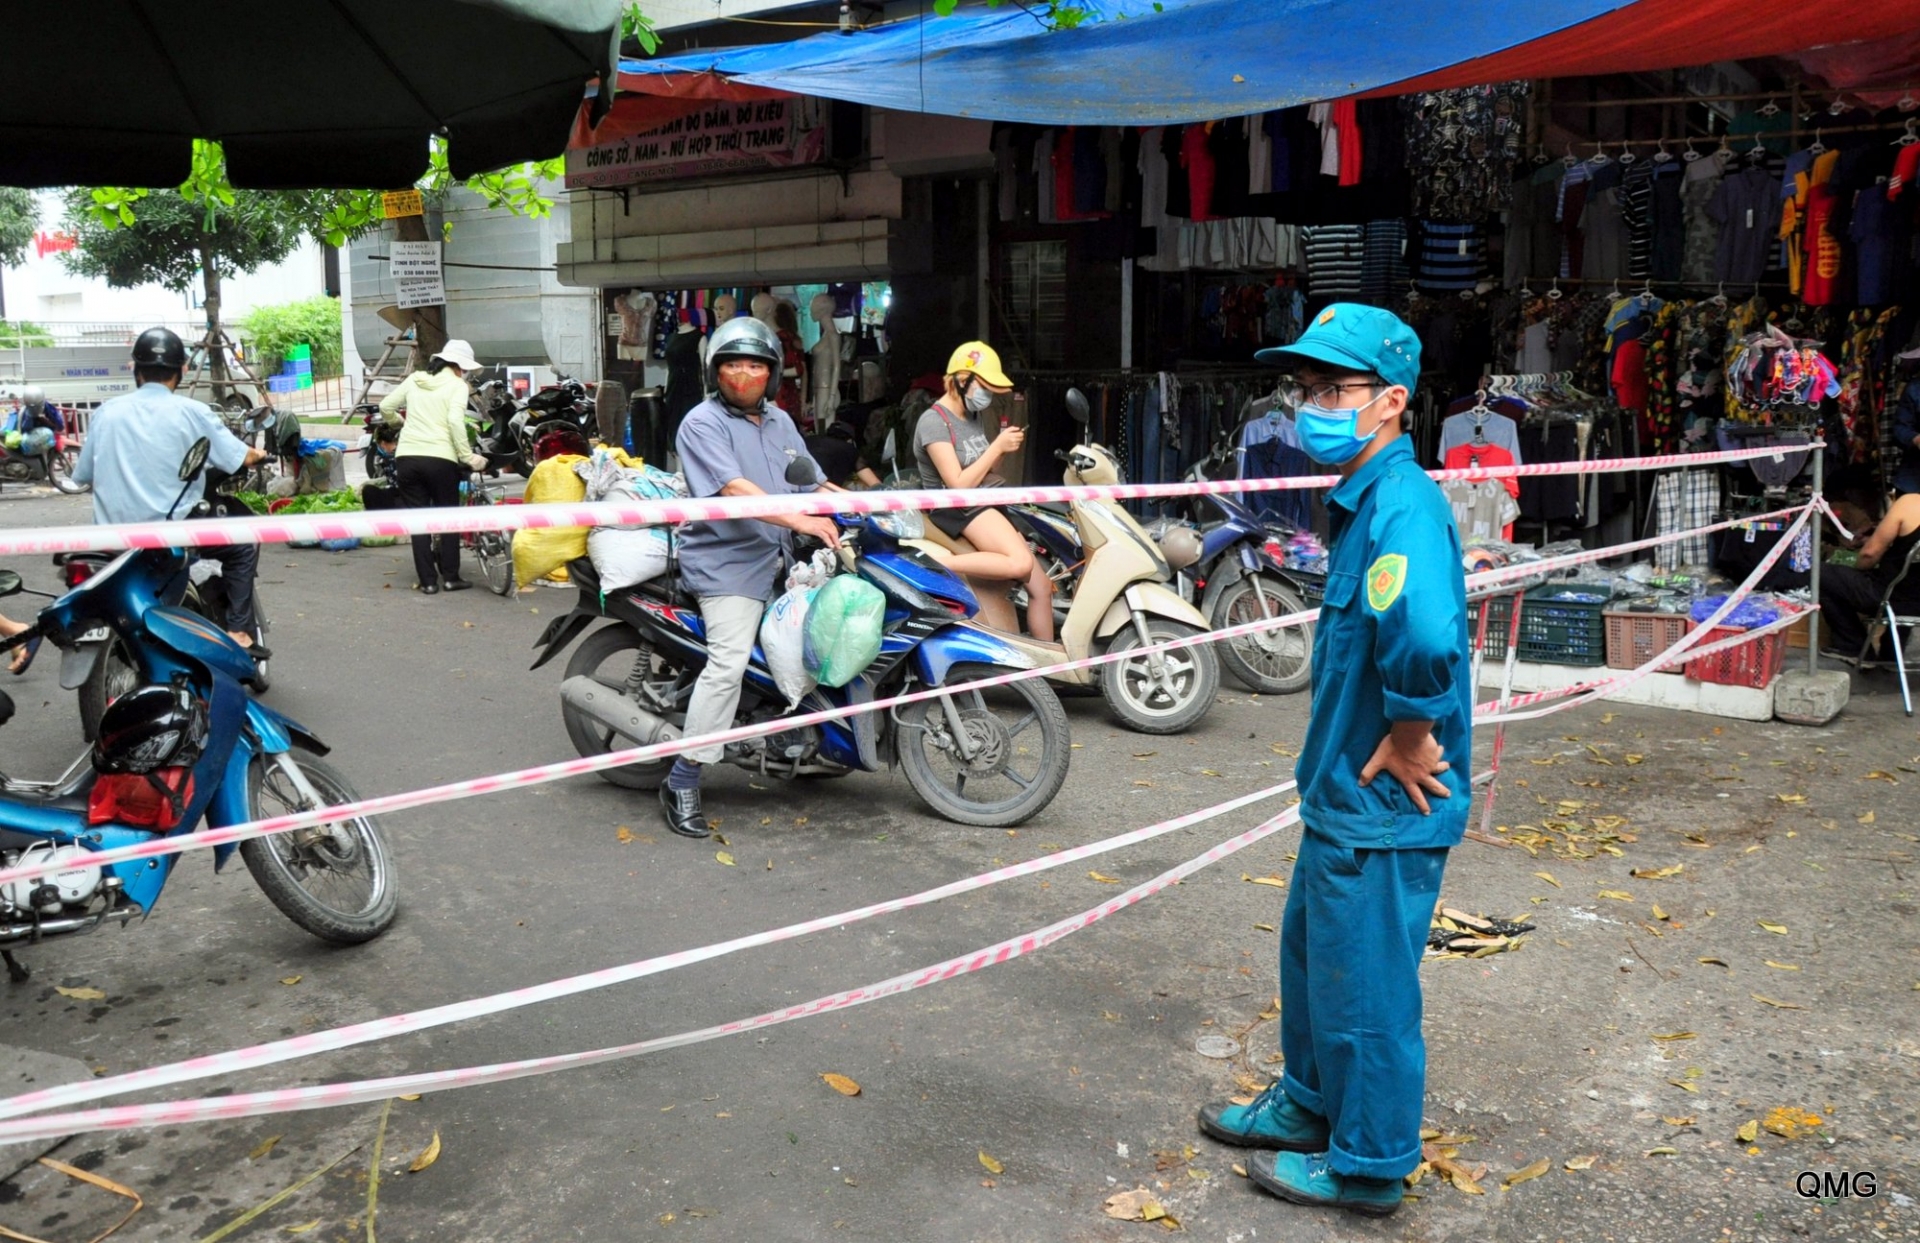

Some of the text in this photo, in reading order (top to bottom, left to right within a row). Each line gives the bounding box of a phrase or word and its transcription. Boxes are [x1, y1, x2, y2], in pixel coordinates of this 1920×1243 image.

[587, 147, 613, 167] CÔNG
[635, 143, 659, 162] NAM
[746, 126, 785, 148] TRANG
[57, 869, 87, 878] HONDA
